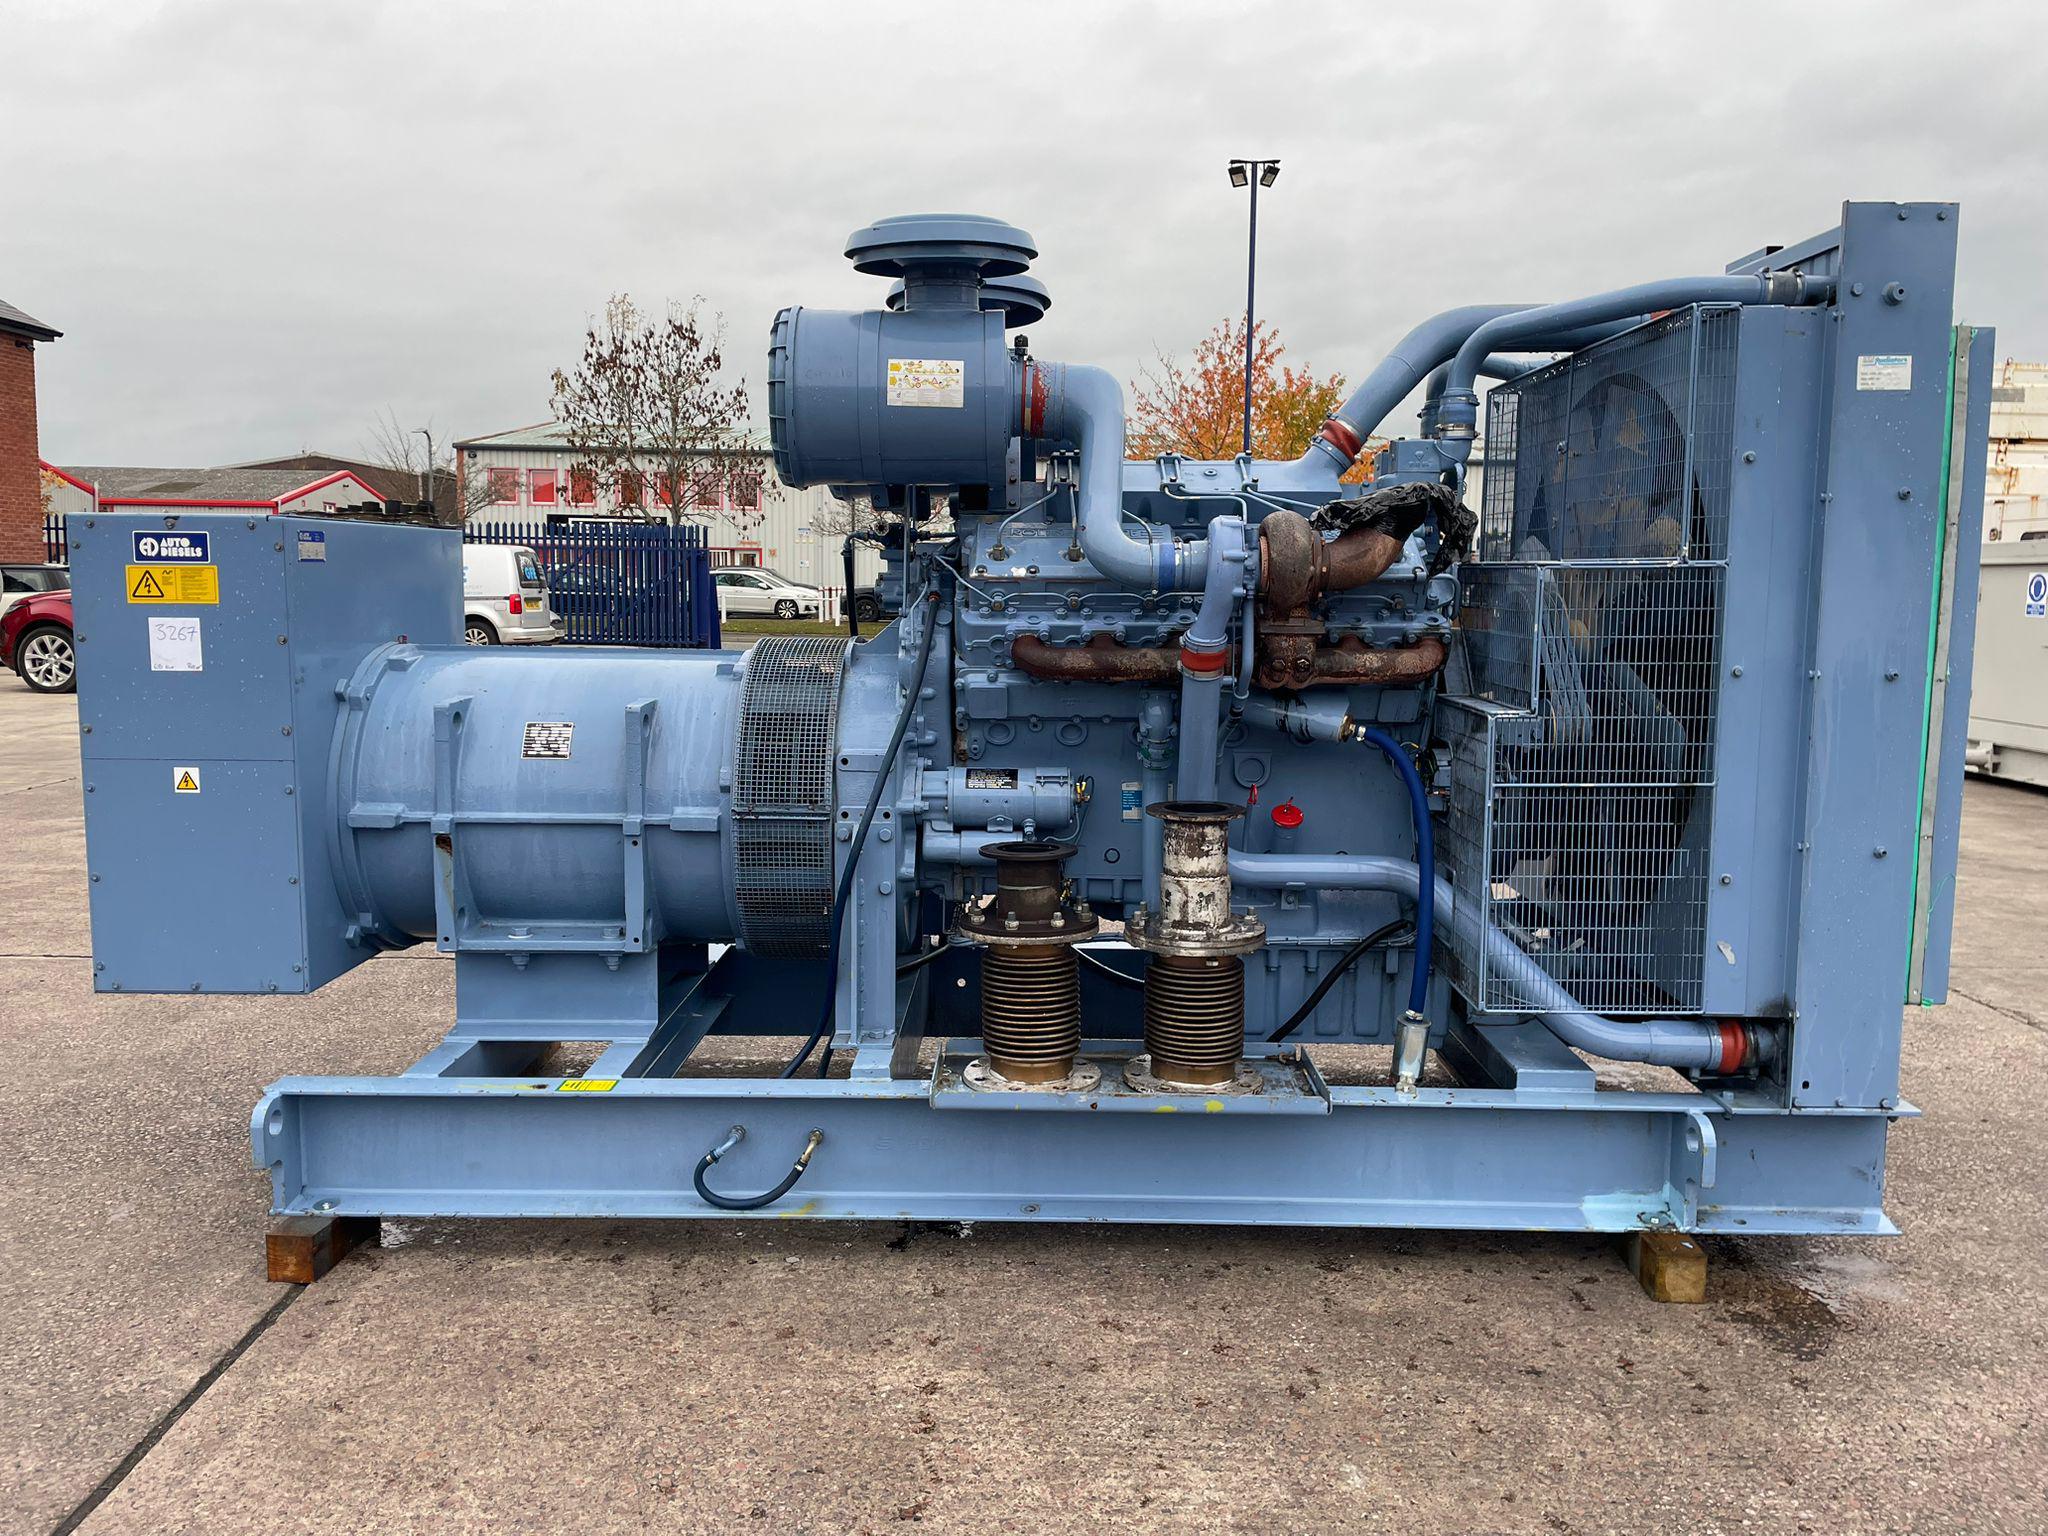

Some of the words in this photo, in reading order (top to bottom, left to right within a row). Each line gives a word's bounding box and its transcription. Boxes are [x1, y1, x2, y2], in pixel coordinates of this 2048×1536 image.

[160, 537, 190, 547] AUTO
[160, 547, 203, 557] DIESELS
[155, 623, 198, 642] 3267
